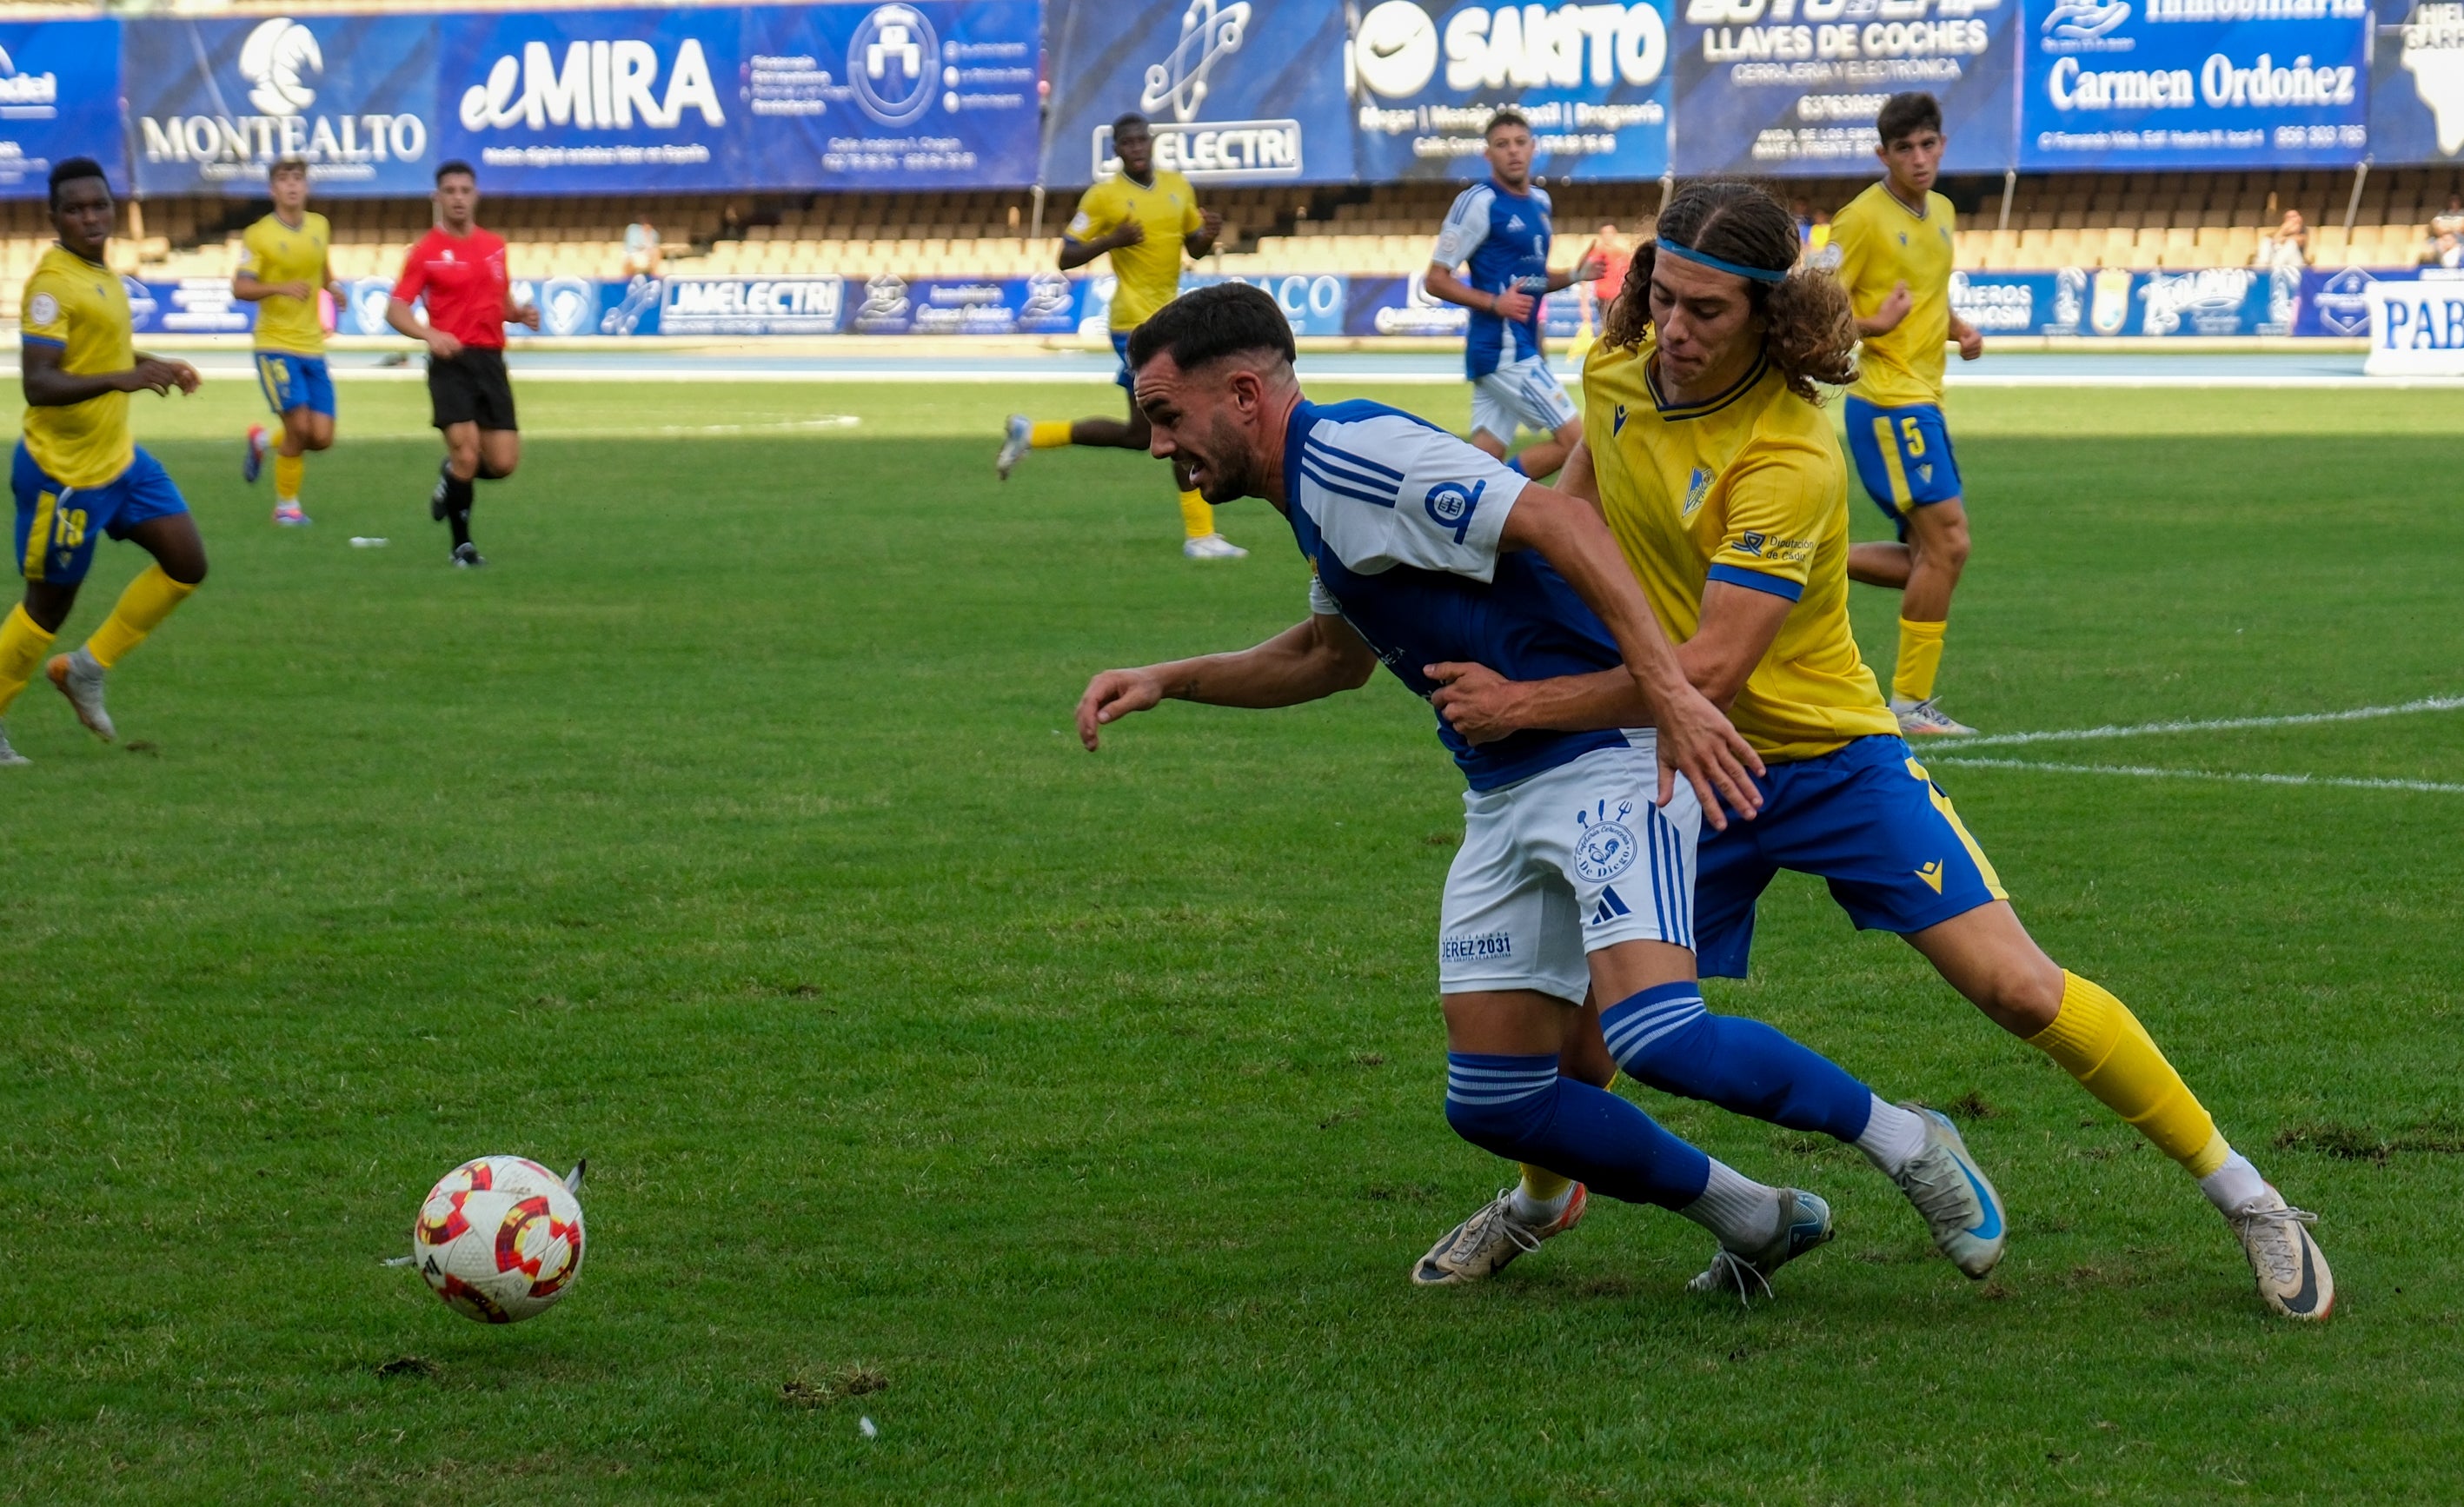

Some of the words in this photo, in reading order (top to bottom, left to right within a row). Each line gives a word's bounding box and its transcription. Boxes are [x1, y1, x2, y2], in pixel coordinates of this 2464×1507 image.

[1702, 24, 1815, 63] LLAVES
[1816, 23, 1860, 59] DE
[1862, 18, 1989, 57] COCHES
[2048, 56, 2195, 110] Carmen
[2201, 53, 2356, 109] Ordoñez
[140, 113, 427, 163] MONTEALTO
[1152, 129, 1295, 170] ELECTRI
[2382, 297, 2464, 349] PAB
[1901, 416, 1926, 457] 5
[1766, 550, 1778, 560] de
[1781, 551, 1806, 562] Cádiz
[1770, 535, 1814, 549] Diputación
[1578, 860, 1593, 877] De
[1597, 852, 1630, 878] Diego
[1442, 940, 1476, 957] JEREZ
[1477, 937, 1511, 954] 2031
